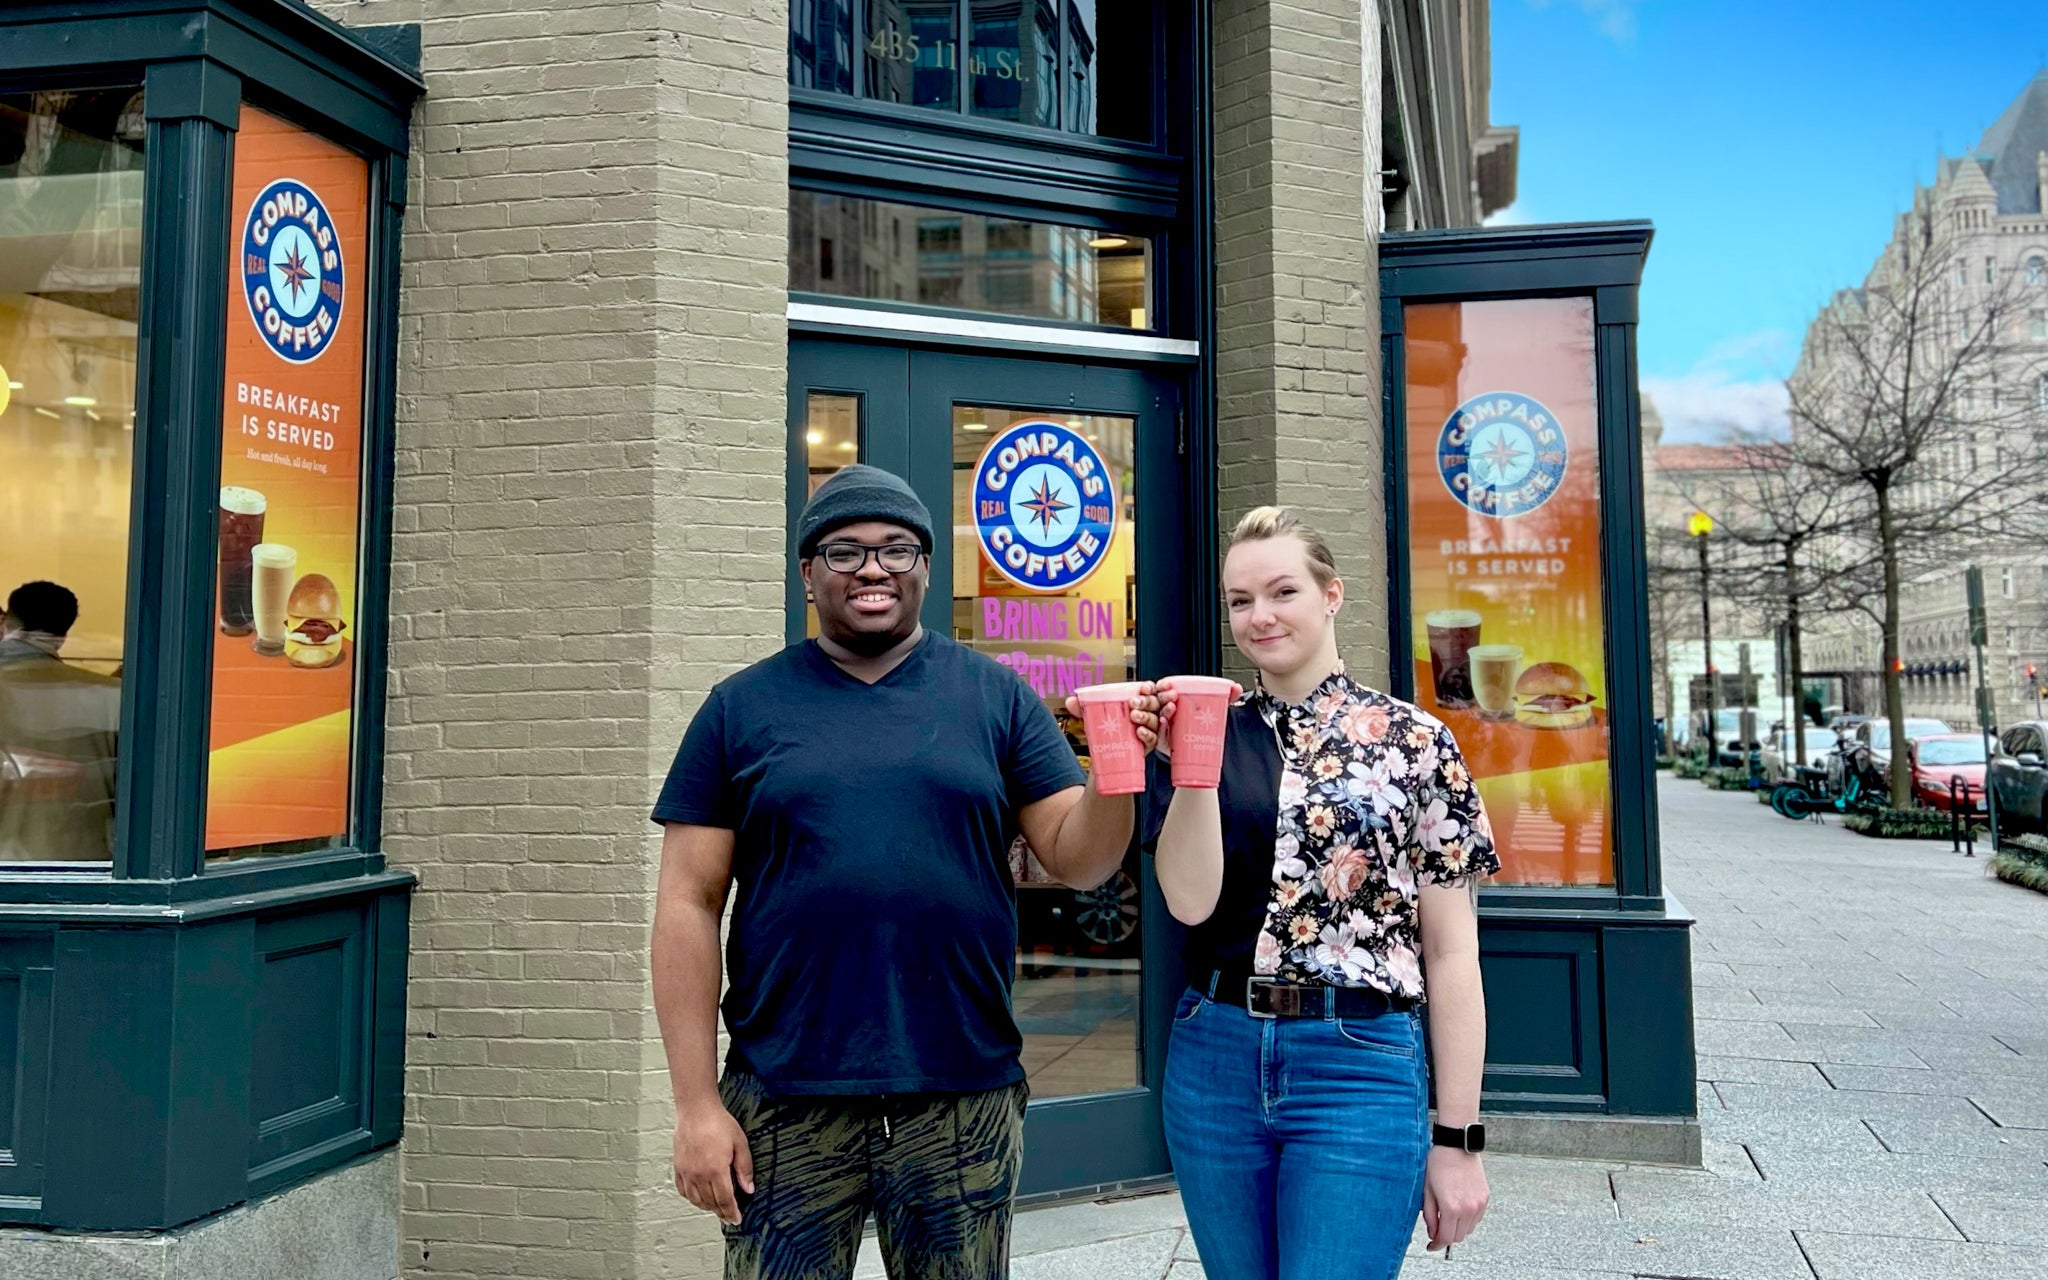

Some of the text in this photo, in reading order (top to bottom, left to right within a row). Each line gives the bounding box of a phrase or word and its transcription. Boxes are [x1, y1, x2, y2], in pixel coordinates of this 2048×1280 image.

[870, 29, 920, 63] 435
[996, 50, 1030, 82] St.
[252, 191, 337, 271] COMPASS
[248, 254, 266, 275] REAL
[253, 285, 333, 352] COFFEE
[237, 382, 340, 424] BREAKFAST
[1448, 399, 1556, 446] COMPASS
[242, 414, 334, 451] IS SERVED
[247, 448, 260, 460] Hot
[260, 452, 273, 463] and
[293, 457, 301, 468] all
[302, 458, 313, 471] day
[985, 432, 1104, 499] COMPASS
[1452, 470, 1554, 510] COFFEE
[981, 500, 1110, 525] REAL GOOD
[990, 525, 1100, 580] COFFEE
[1447, 558, 1566, 576] IS SERVED
[983, 597, 1113, 642] BRING ON
